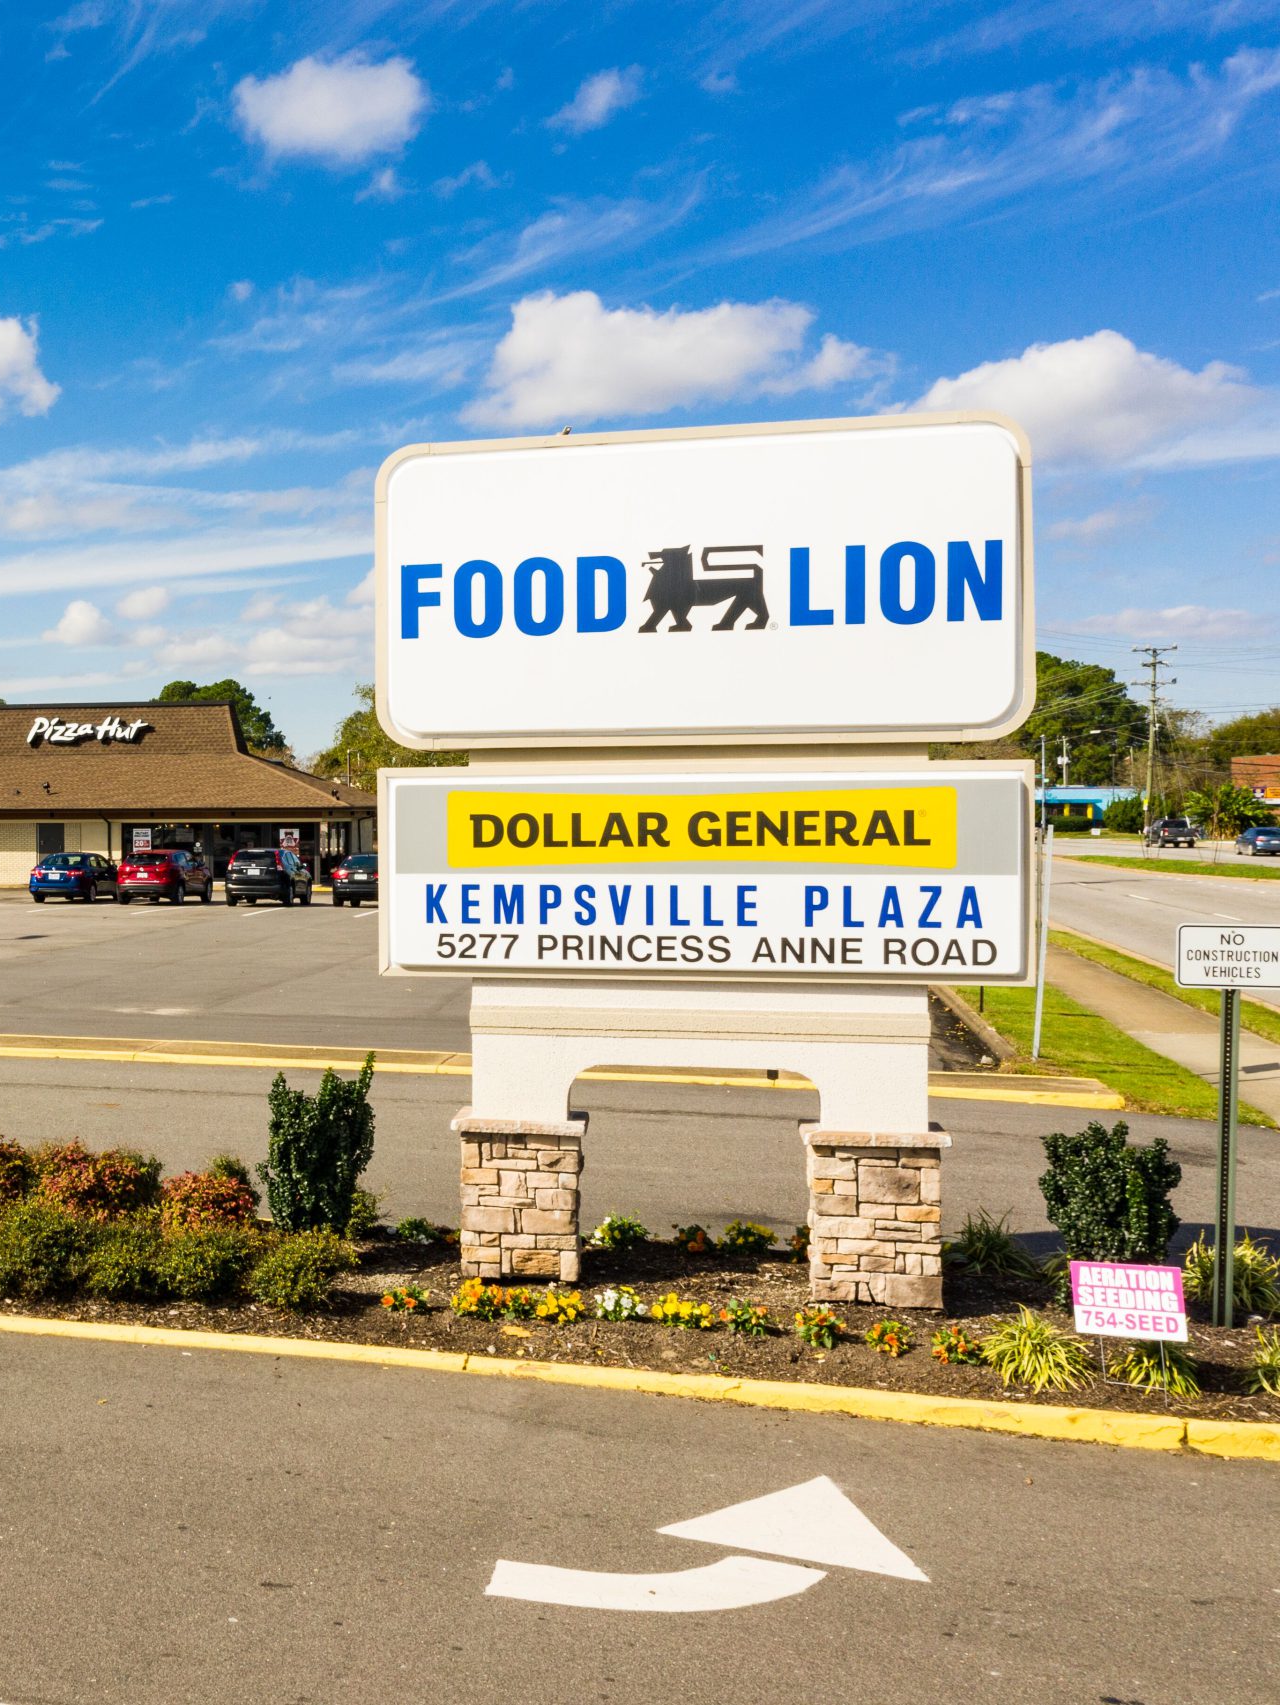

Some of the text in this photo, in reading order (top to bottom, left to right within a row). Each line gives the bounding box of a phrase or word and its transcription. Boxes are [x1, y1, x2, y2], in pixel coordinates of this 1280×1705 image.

[401, 539, 1003, 640] FOOD LION
[26, 716, 149, 743] Pizza Hut
[469, 810, 932, 849] DOLLAR GENERAL
[426, 884, 983, 929] KEMPSVILLE PLAZA
[437, 933, 998, 967] 5277 PRINCESS ANNE ROAD
[1220, 933, 1245, 946] NO
[1186, 949, 1279, 963] CONSTRUCTION
[1203, 966, 1261, 979] VEHICLES
[1078, 1266, 1175, 1291] AERATION
[1077, 1286, 1179, 1312] SEEDING
[1081, 1310, 1179, 1334] 754-SEED
